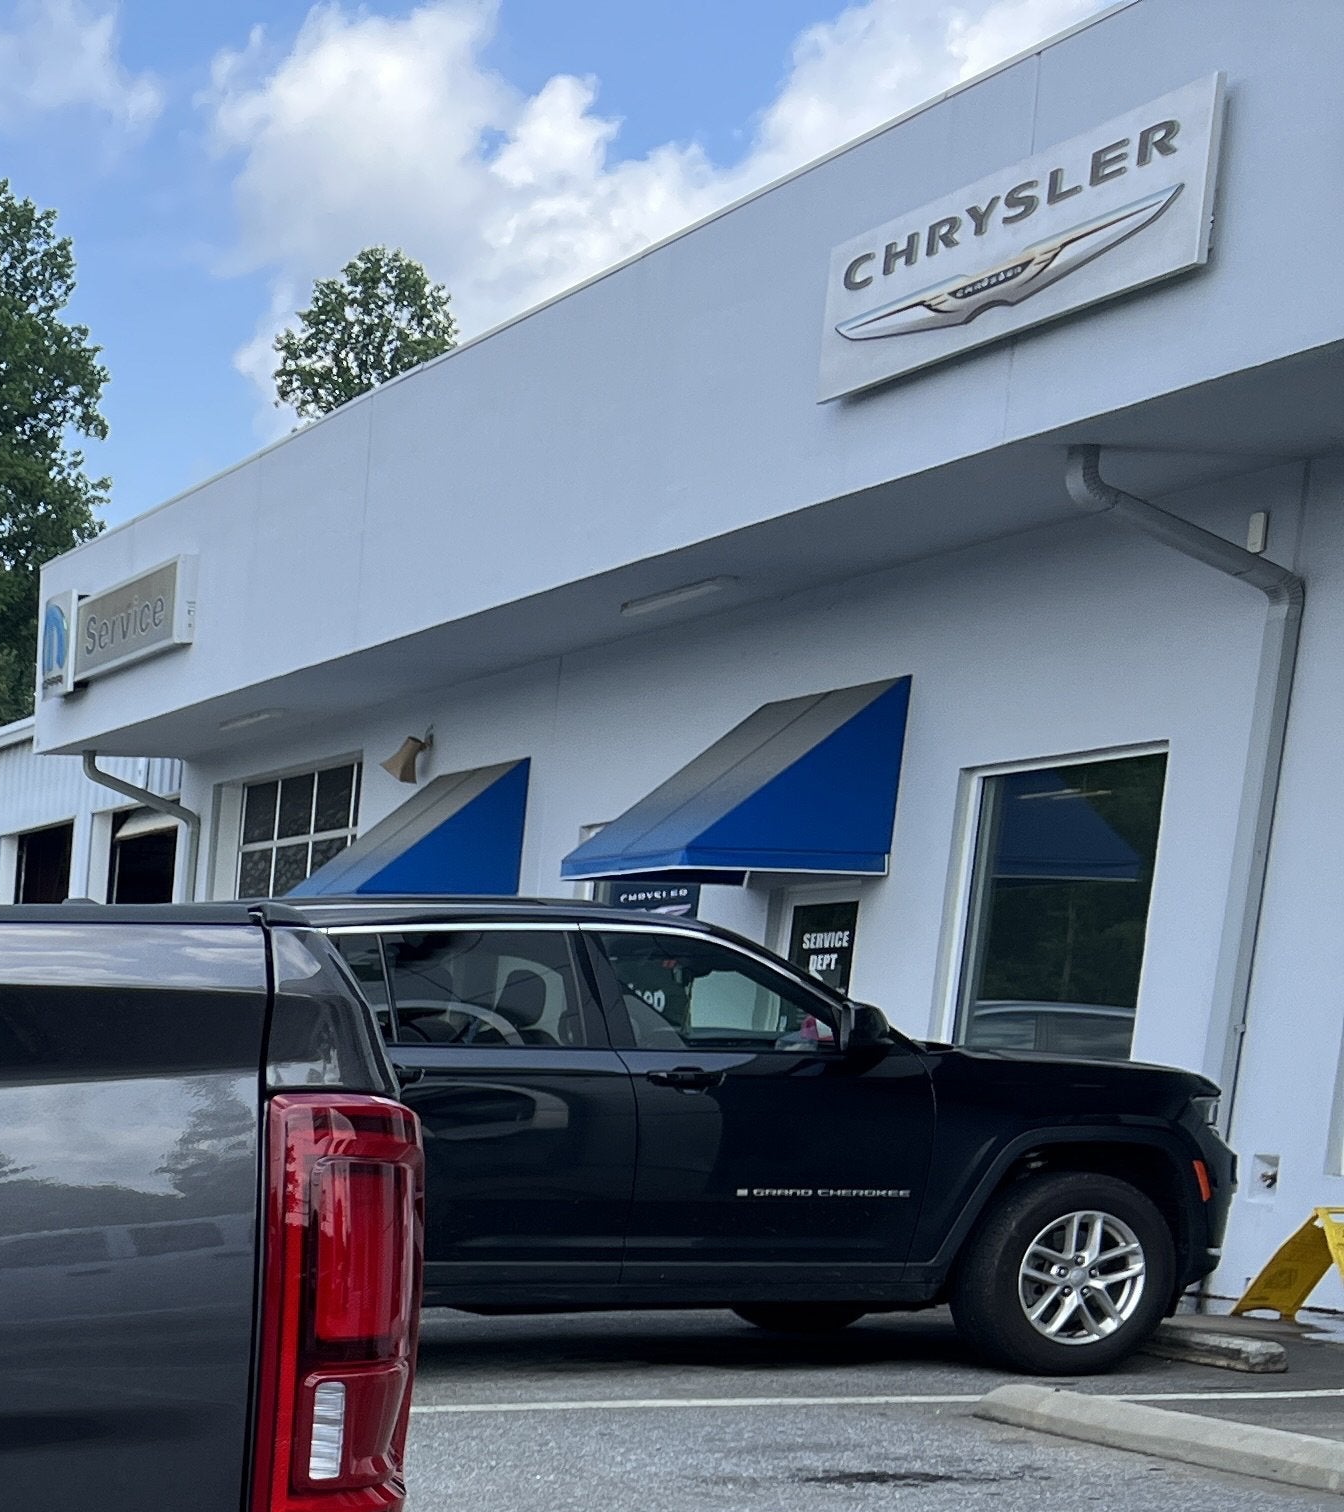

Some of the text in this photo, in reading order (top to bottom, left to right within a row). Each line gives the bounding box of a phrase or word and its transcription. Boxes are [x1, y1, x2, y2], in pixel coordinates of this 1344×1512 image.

[844, 119, 1181, 291] CHRYSLER
[85, 595, 165, 656] Service
[802, 930, 851, 950] SERVICE
[809, 953, 839, 972] DEPT
[752, 1187, 912, 1198] GRAND CHEROKEE
